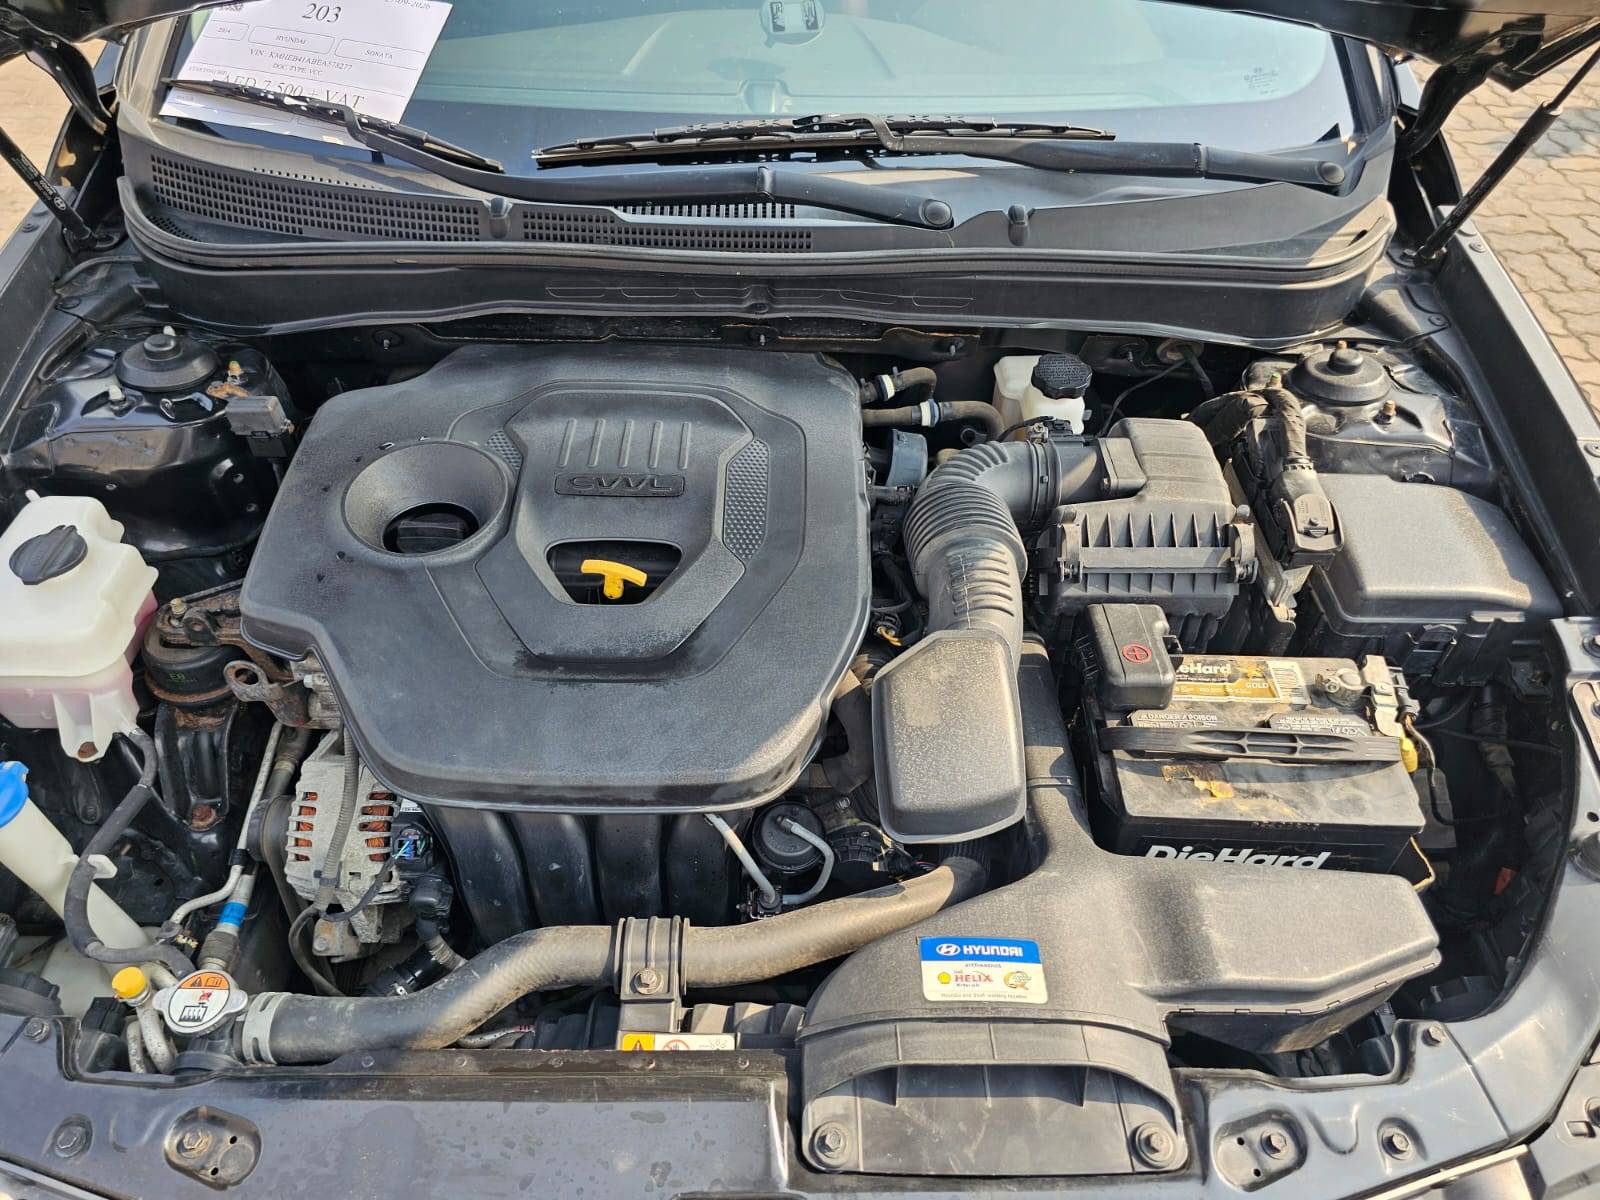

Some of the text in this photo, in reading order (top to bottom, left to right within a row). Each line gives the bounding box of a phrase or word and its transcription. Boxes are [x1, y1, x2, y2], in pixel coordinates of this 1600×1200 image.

[302, 3, 342, 23] 203
[275, 35, 307, 45] HYUNDAI
[365, 50, 393, 60] SONATA
[264, 80, 304, 96] 7500
[326, 89, 365, 108] VAT
[1176, 662, 1232, 676] eHard
[1245, 681, 1269, 689] GOLD
[963, 944, 1023, 957] HYUNDAI
[954, 974, 993, 983] HELIX
